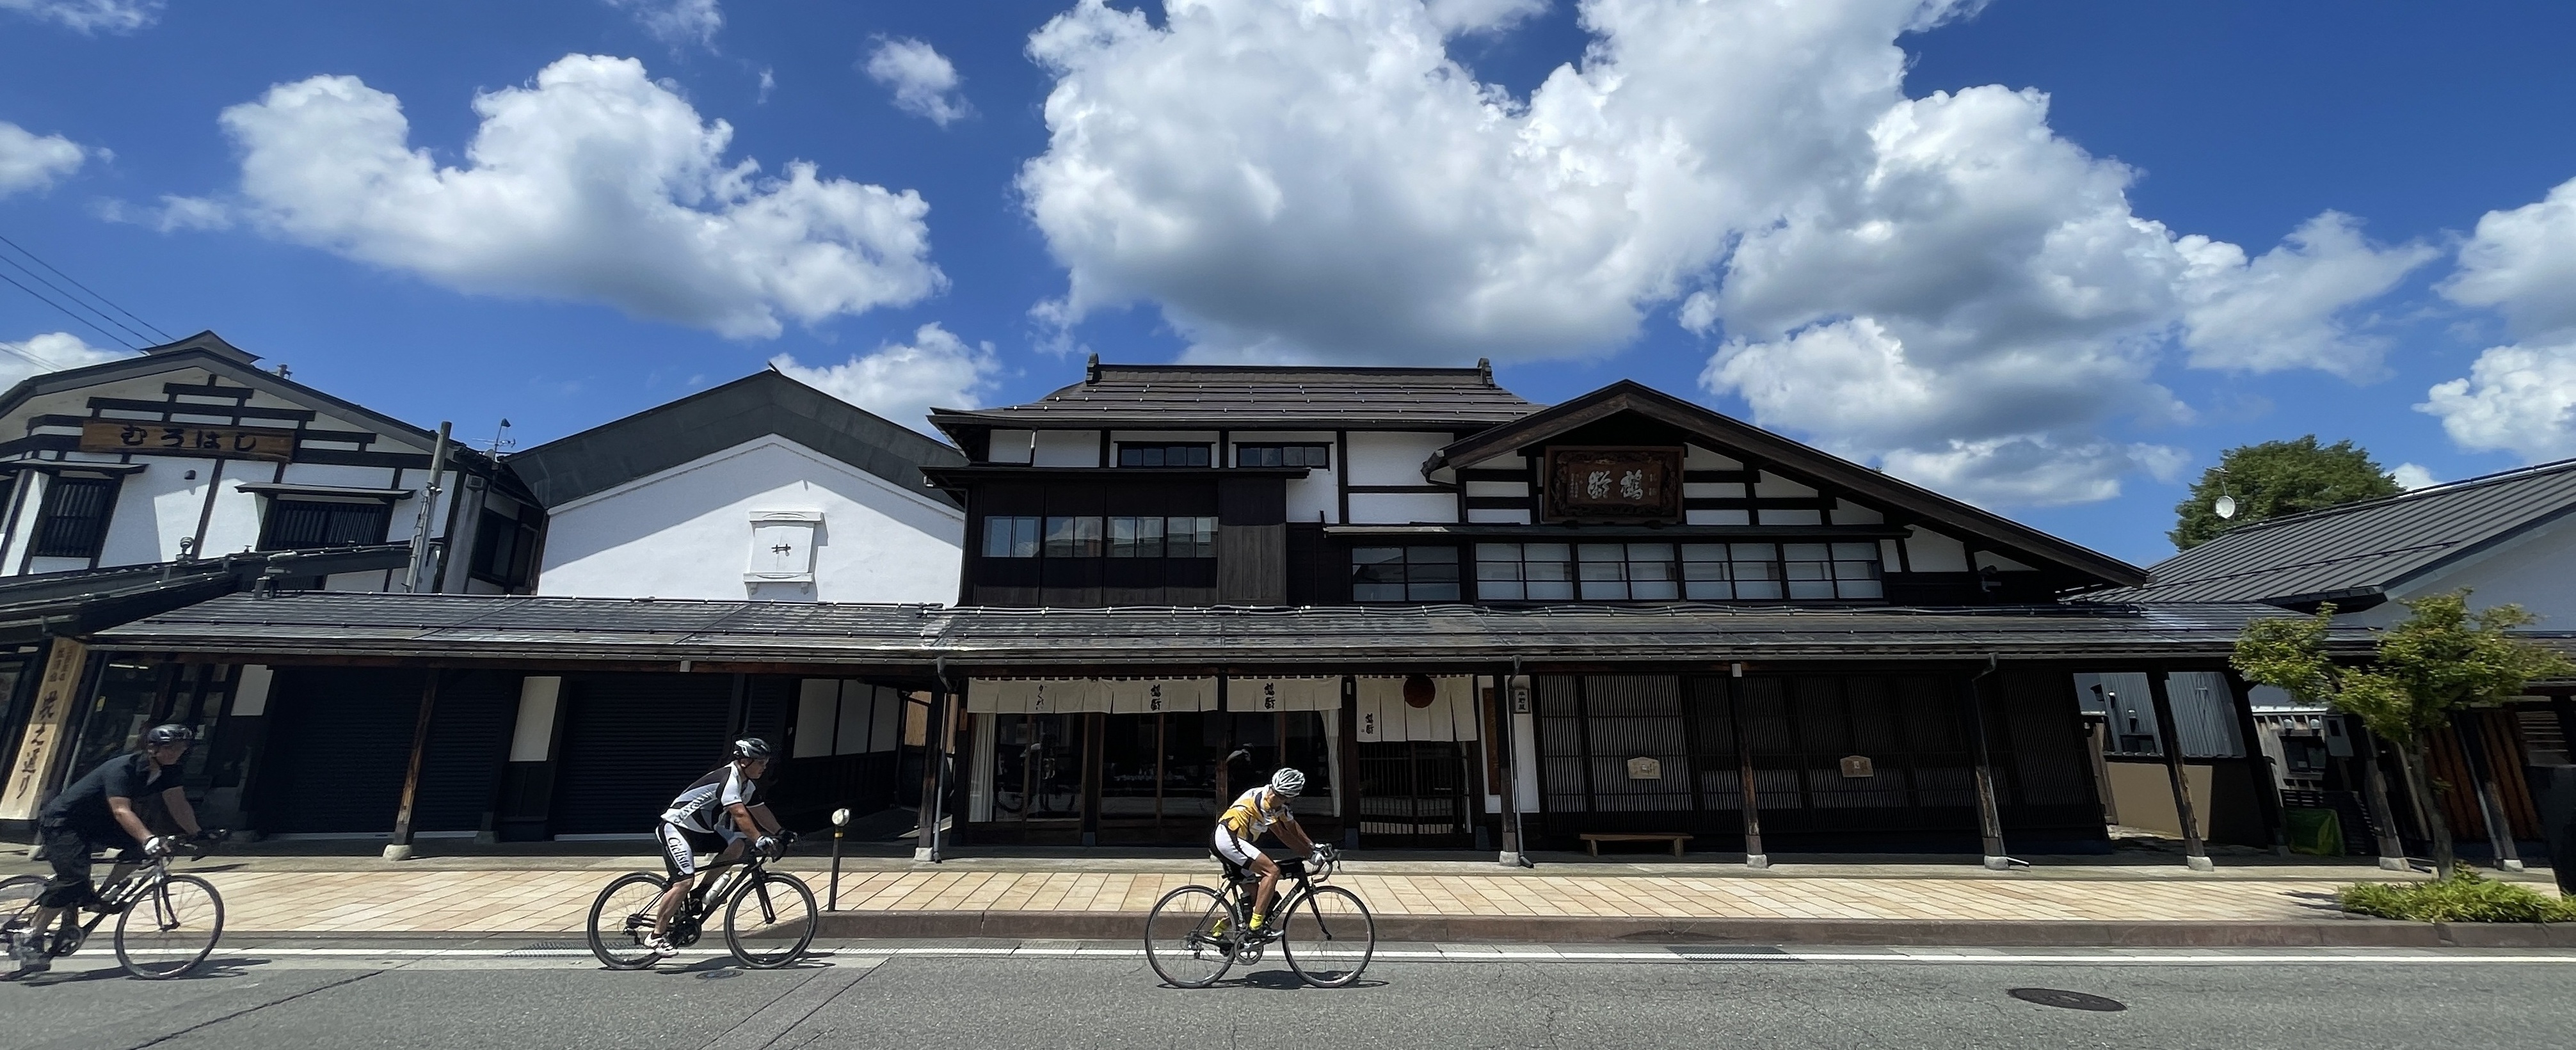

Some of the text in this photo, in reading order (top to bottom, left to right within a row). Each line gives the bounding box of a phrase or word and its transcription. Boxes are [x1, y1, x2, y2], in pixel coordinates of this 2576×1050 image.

[121, 425, 255, 452] むろはし
[668, 837, 691, 869] Ciclista
